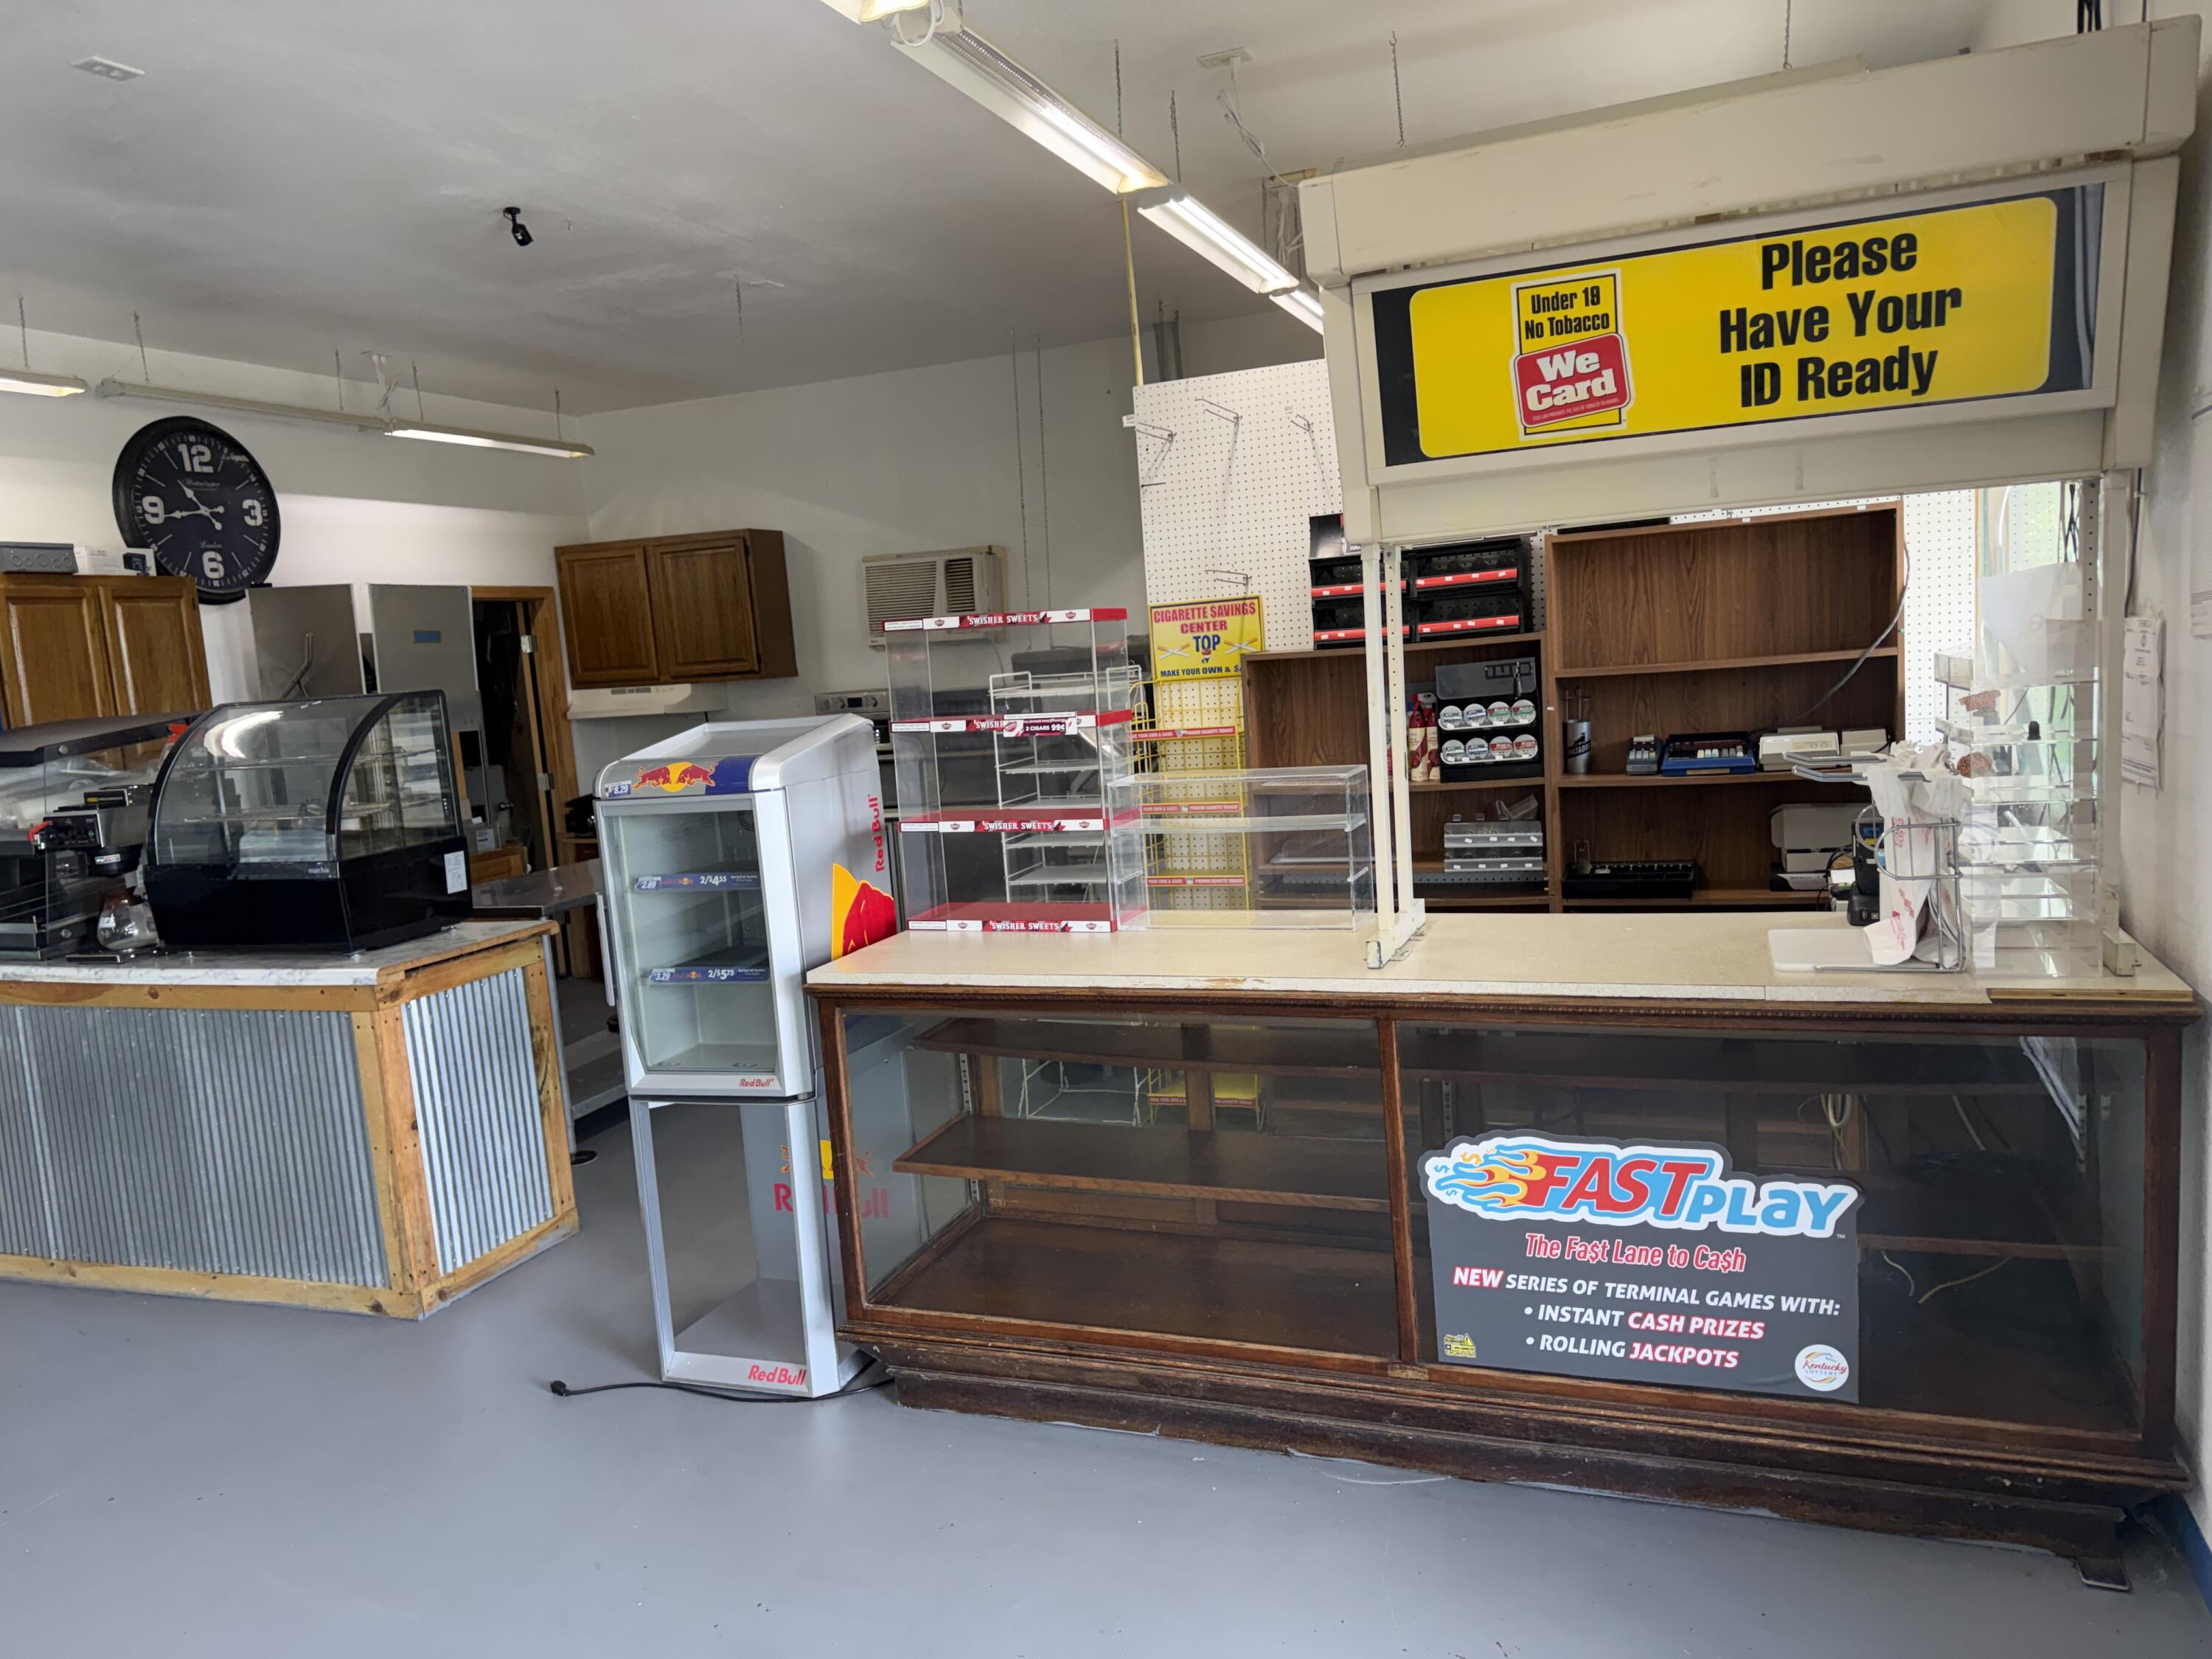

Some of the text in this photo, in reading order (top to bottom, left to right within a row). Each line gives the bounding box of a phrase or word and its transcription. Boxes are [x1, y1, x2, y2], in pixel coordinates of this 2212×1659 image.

[1762, 233, 1917, 291] Please
[1531, 291, 1578, 315] Under
[1525, 313, 1610, 340] No Tobacco
[1720, 288, 1962, 354] Have Your
[1536, 349, 1601, 383] We
[1741, 345, 1938, 408] ID Ready
[1526, 368, 1618, 411] Card
[178, 444, 214, 473] 12
[142, 495, 165, 524] 9
[242, 499, 263, 526] 3
[202, 551, 224, 579] 6
[967, 614, 1038, 625] SWISHER SWEETS
[1154, 606, 1208, 623] CIGARETTE
[1180, 620, 1228, 633] CENTER
[1192, 634, 1221, 652] TOP
[1161, 669, 1180, 677] MAKE
[1202, 666, 1222, 674] OWN
[974, 720, 1004, 728] SWISHE
[869, 797, 885, 872] Red Bull
[982, 821, 1018, 830] SWISHER
[990, 920, 1026, 930] SWISHER
[740, 1079, 771, 1087] Red Bull
[1519, 1153, 1709, 1216] FAST
[1526, 1233, 1746, 1273] The Fa$t Lane to Ca$h
[1453, 1267, 1841, 1316] NEW SERIES OF TERMINAL GAMES WITH:
[1538, 1304, 1765, 1339] INSTANT CASH PRIZES
[1540, 1334, 1739, 1369] ROLLING JACKPOTS
[748, 1365, 807, 1385] Red Bull
[1803, 1360, 1847, 1374] Kentucky
